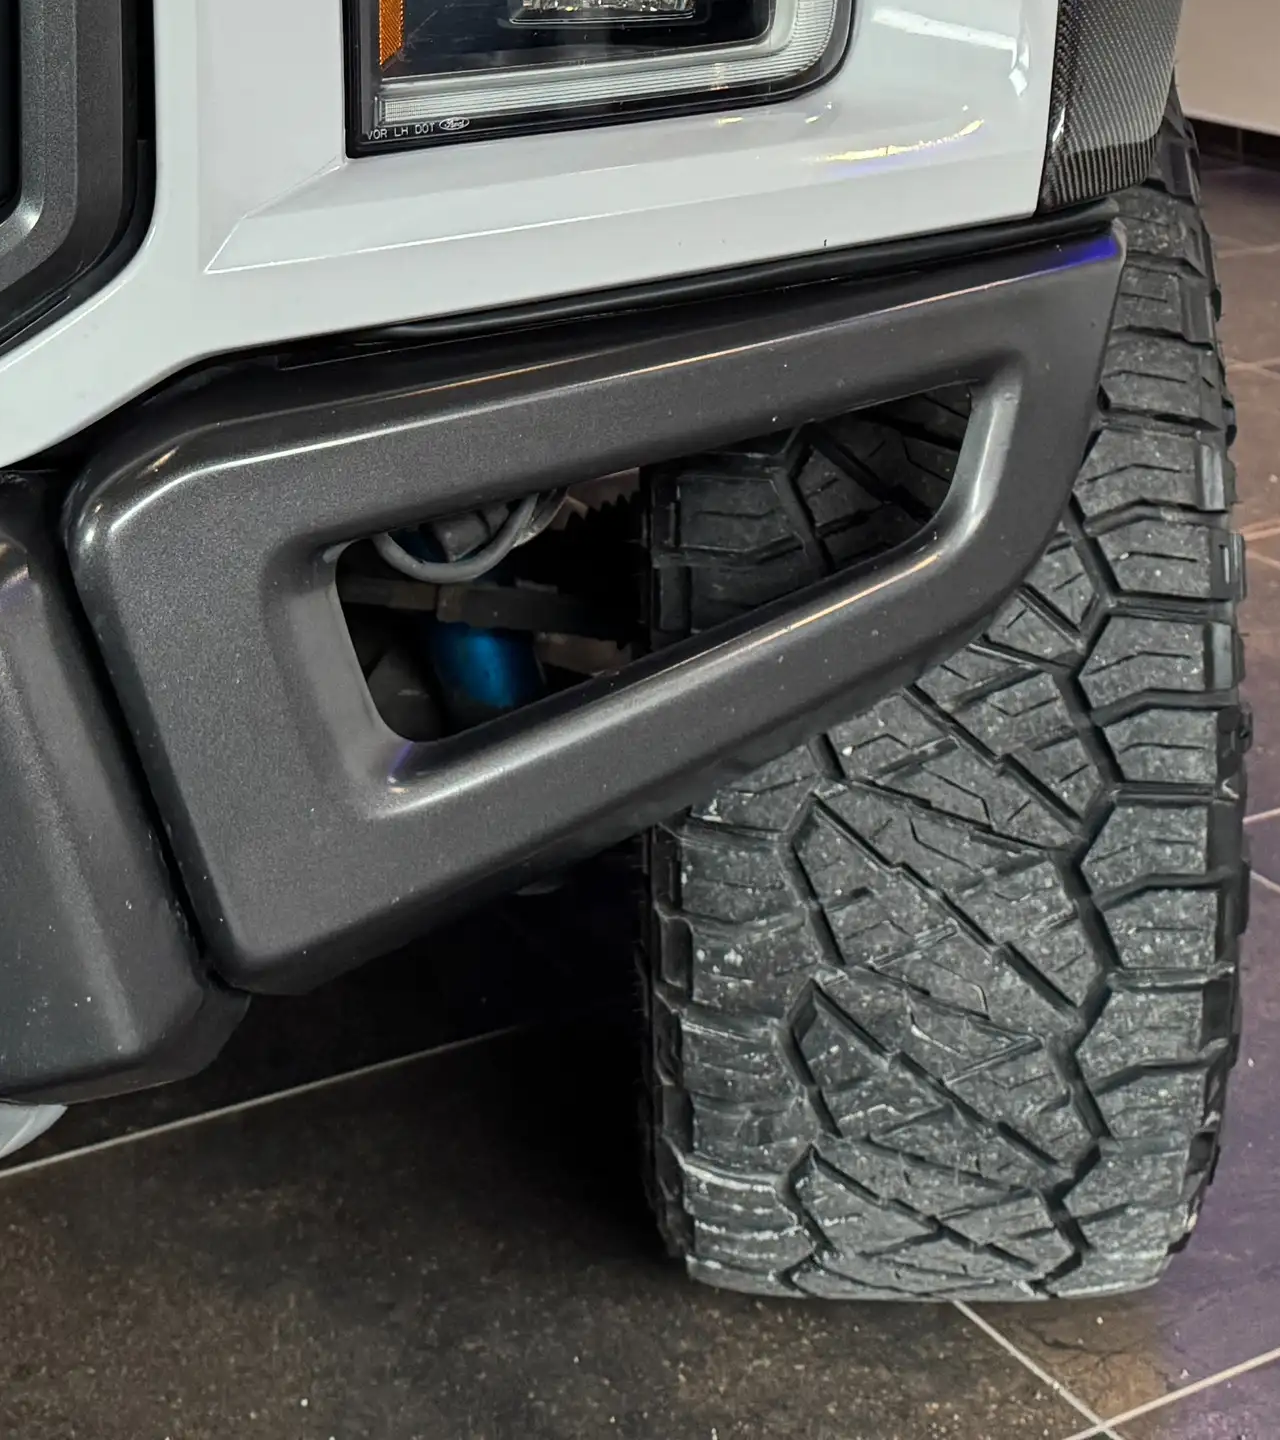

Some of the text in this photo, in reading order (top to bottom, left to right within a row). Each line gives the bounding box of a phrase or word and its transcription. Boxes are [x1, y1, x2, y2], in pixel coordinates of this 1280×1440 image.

[366, 118, 467, 141] VOR LH DOT Ford
